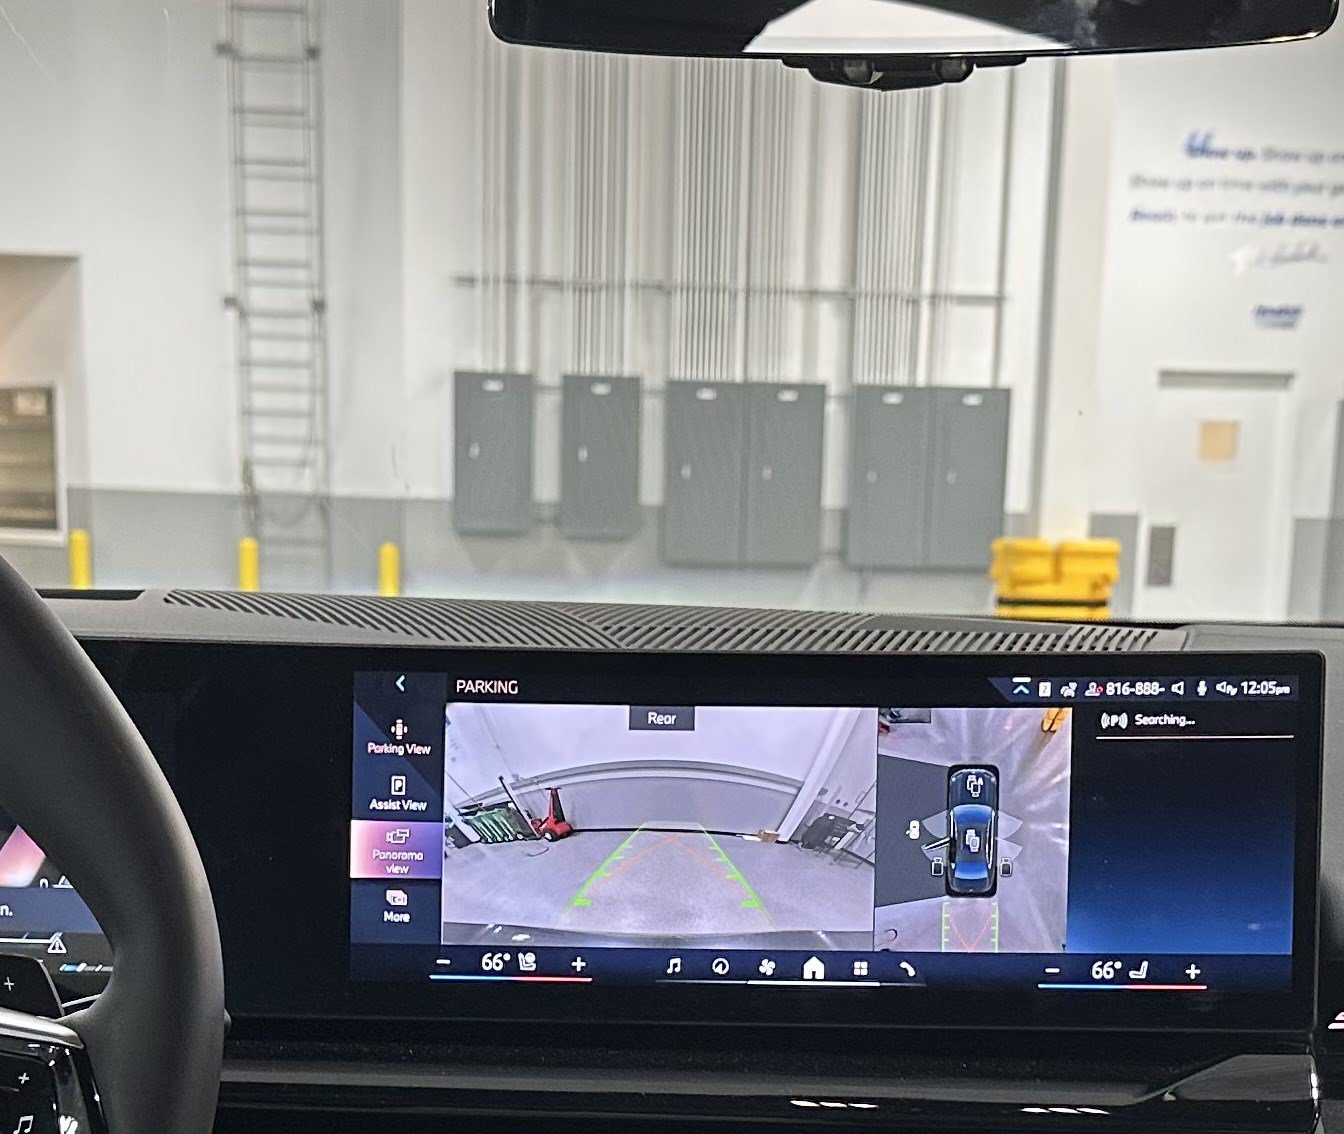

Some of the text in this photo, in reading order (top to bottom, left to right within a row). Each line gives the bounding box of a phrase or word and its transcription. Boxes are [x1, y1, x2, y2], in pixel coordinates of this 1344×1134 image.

[456, 679, 519, 695] PARKING
[647, 711, 677, 725] Rear
[367, 742, 432, 756] Parking View
[369, 799, 428, 811] Assist View
[372, 849, 424, 861] Panorama
[386, 864, 410, 874] view
[383, 911, 411, 923] More
